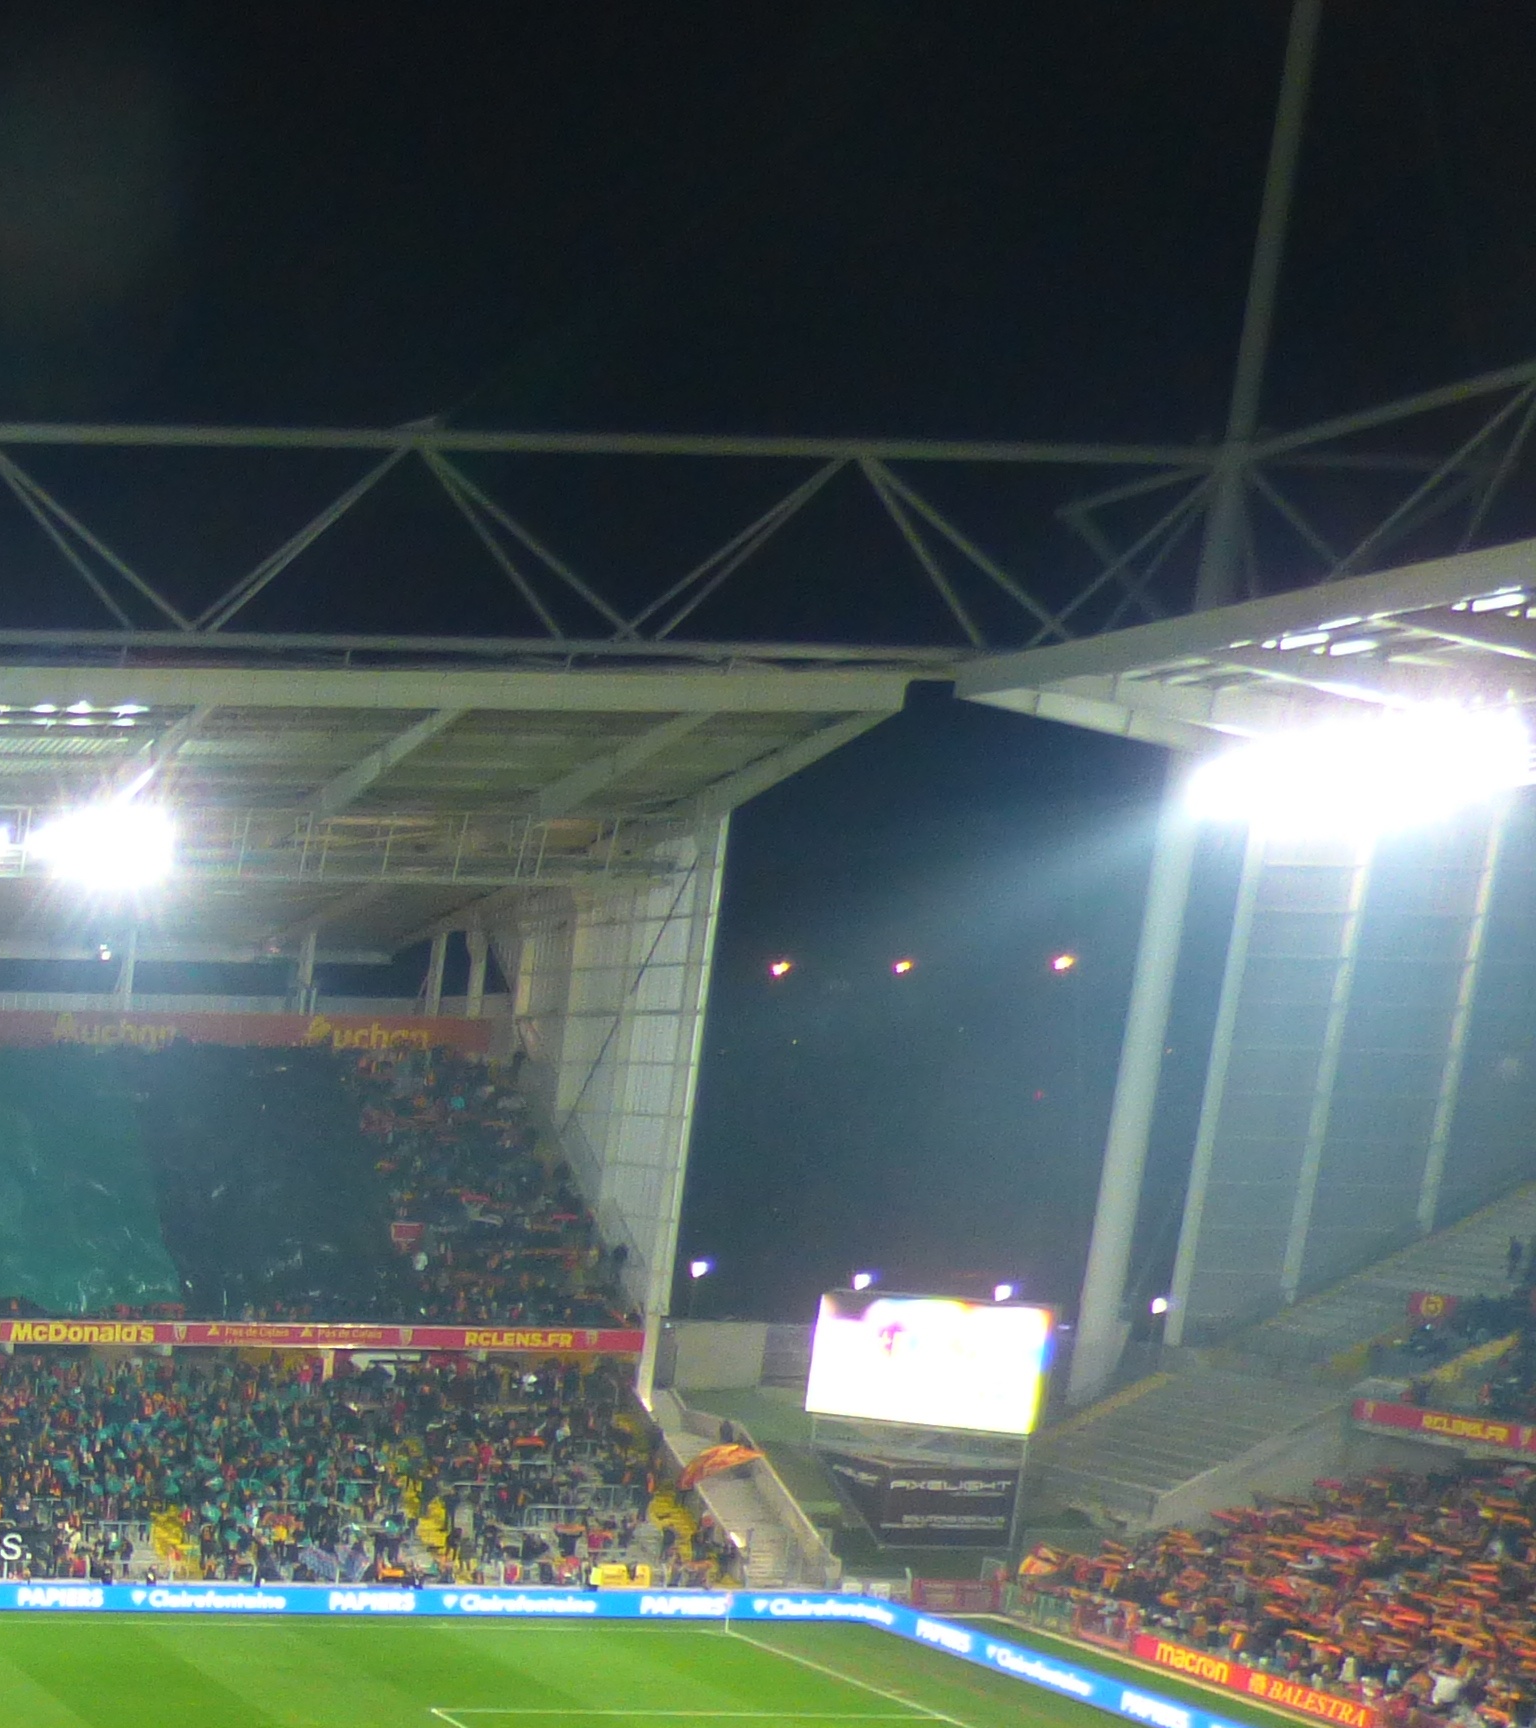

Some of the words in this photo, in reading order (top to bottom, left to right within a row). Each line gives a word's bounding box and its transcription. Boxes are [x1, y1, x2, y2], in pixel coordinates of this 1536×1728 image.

[11, 1321, 154, 1343] McDonald's
[465, 1331, 573, 1348] RCLENS.FR
[1155, 1642, 1229, 1685] macron
[1268, 1682, 1367, 1728] BALESTRA
